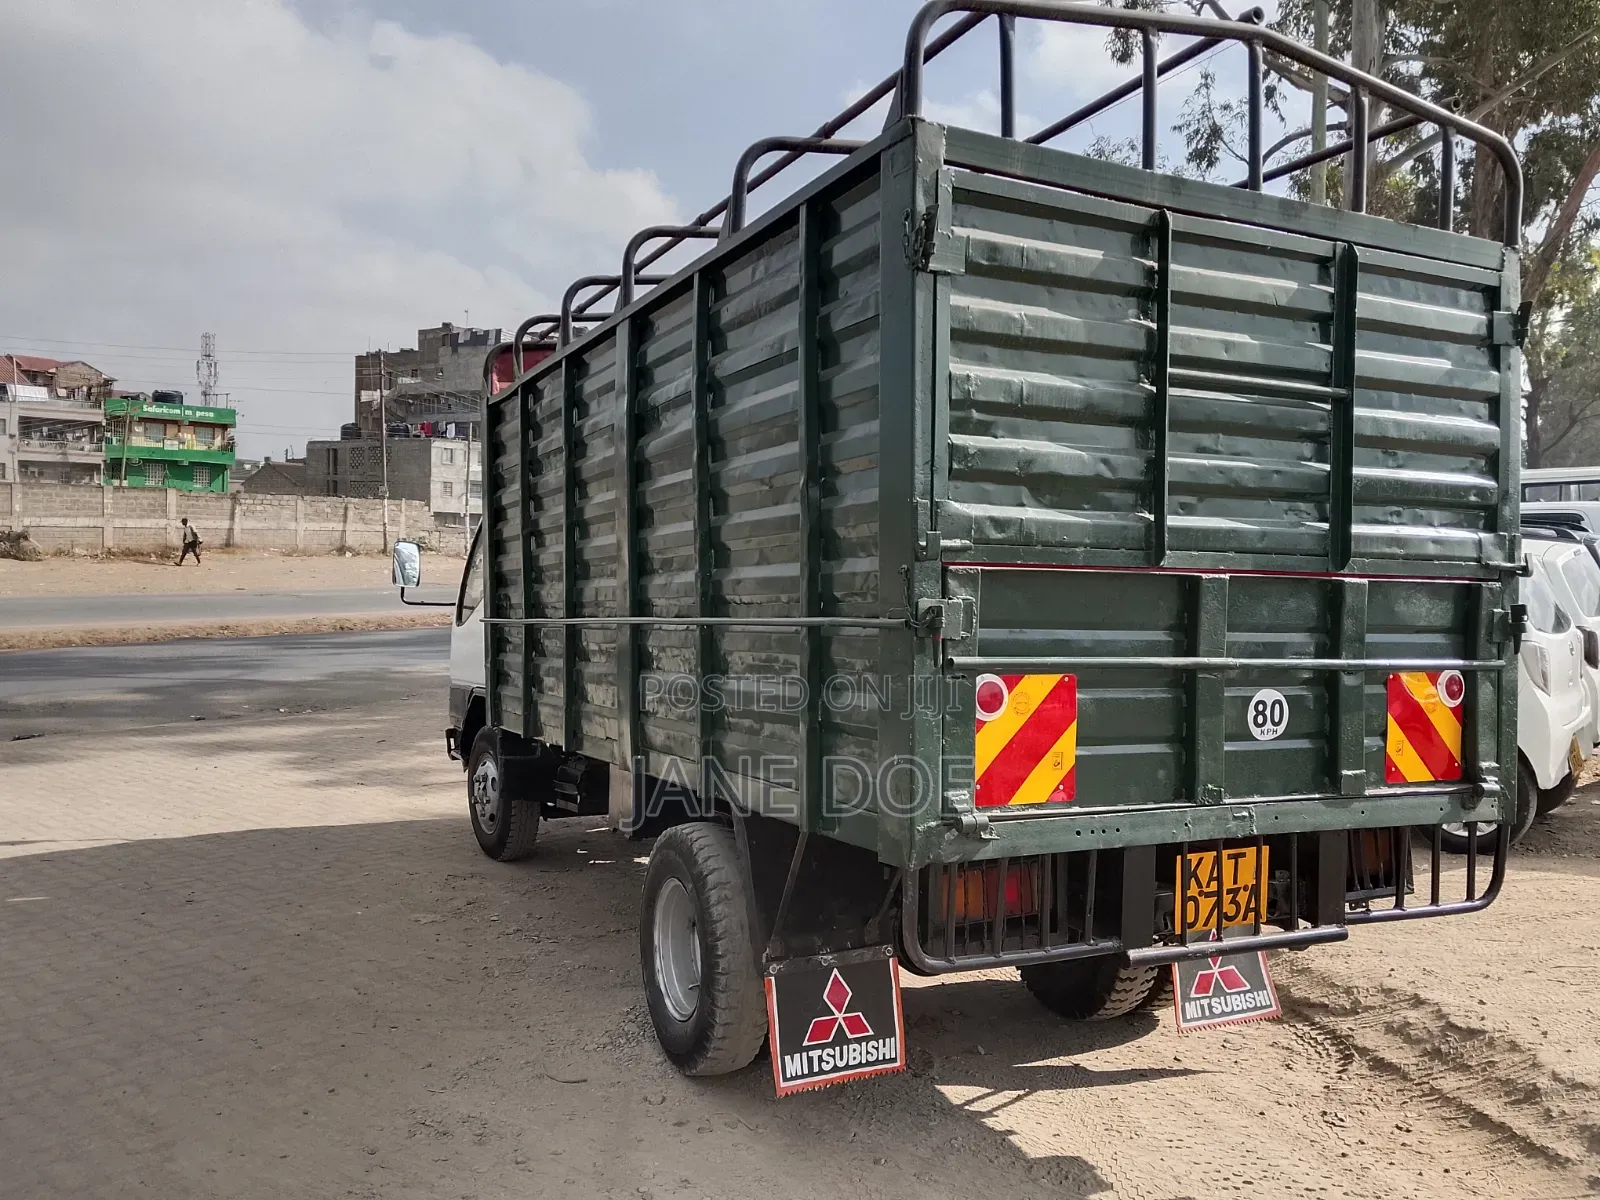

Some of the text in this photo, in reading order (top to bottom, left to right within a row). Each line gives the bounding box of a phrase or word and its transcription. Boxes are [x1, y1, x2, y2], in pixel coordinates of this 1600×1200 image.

[142, 404, 181, 415] Safaricom
[196, 410, 214, 418] pesa
[1252, 698, 1285, 728] 80
[1260, 727, 1278, 736] KPH
[1184, 989, 1271, 1020] MITSUBISHI
[783, 1036, 897, 1079] MITSUBISHI
